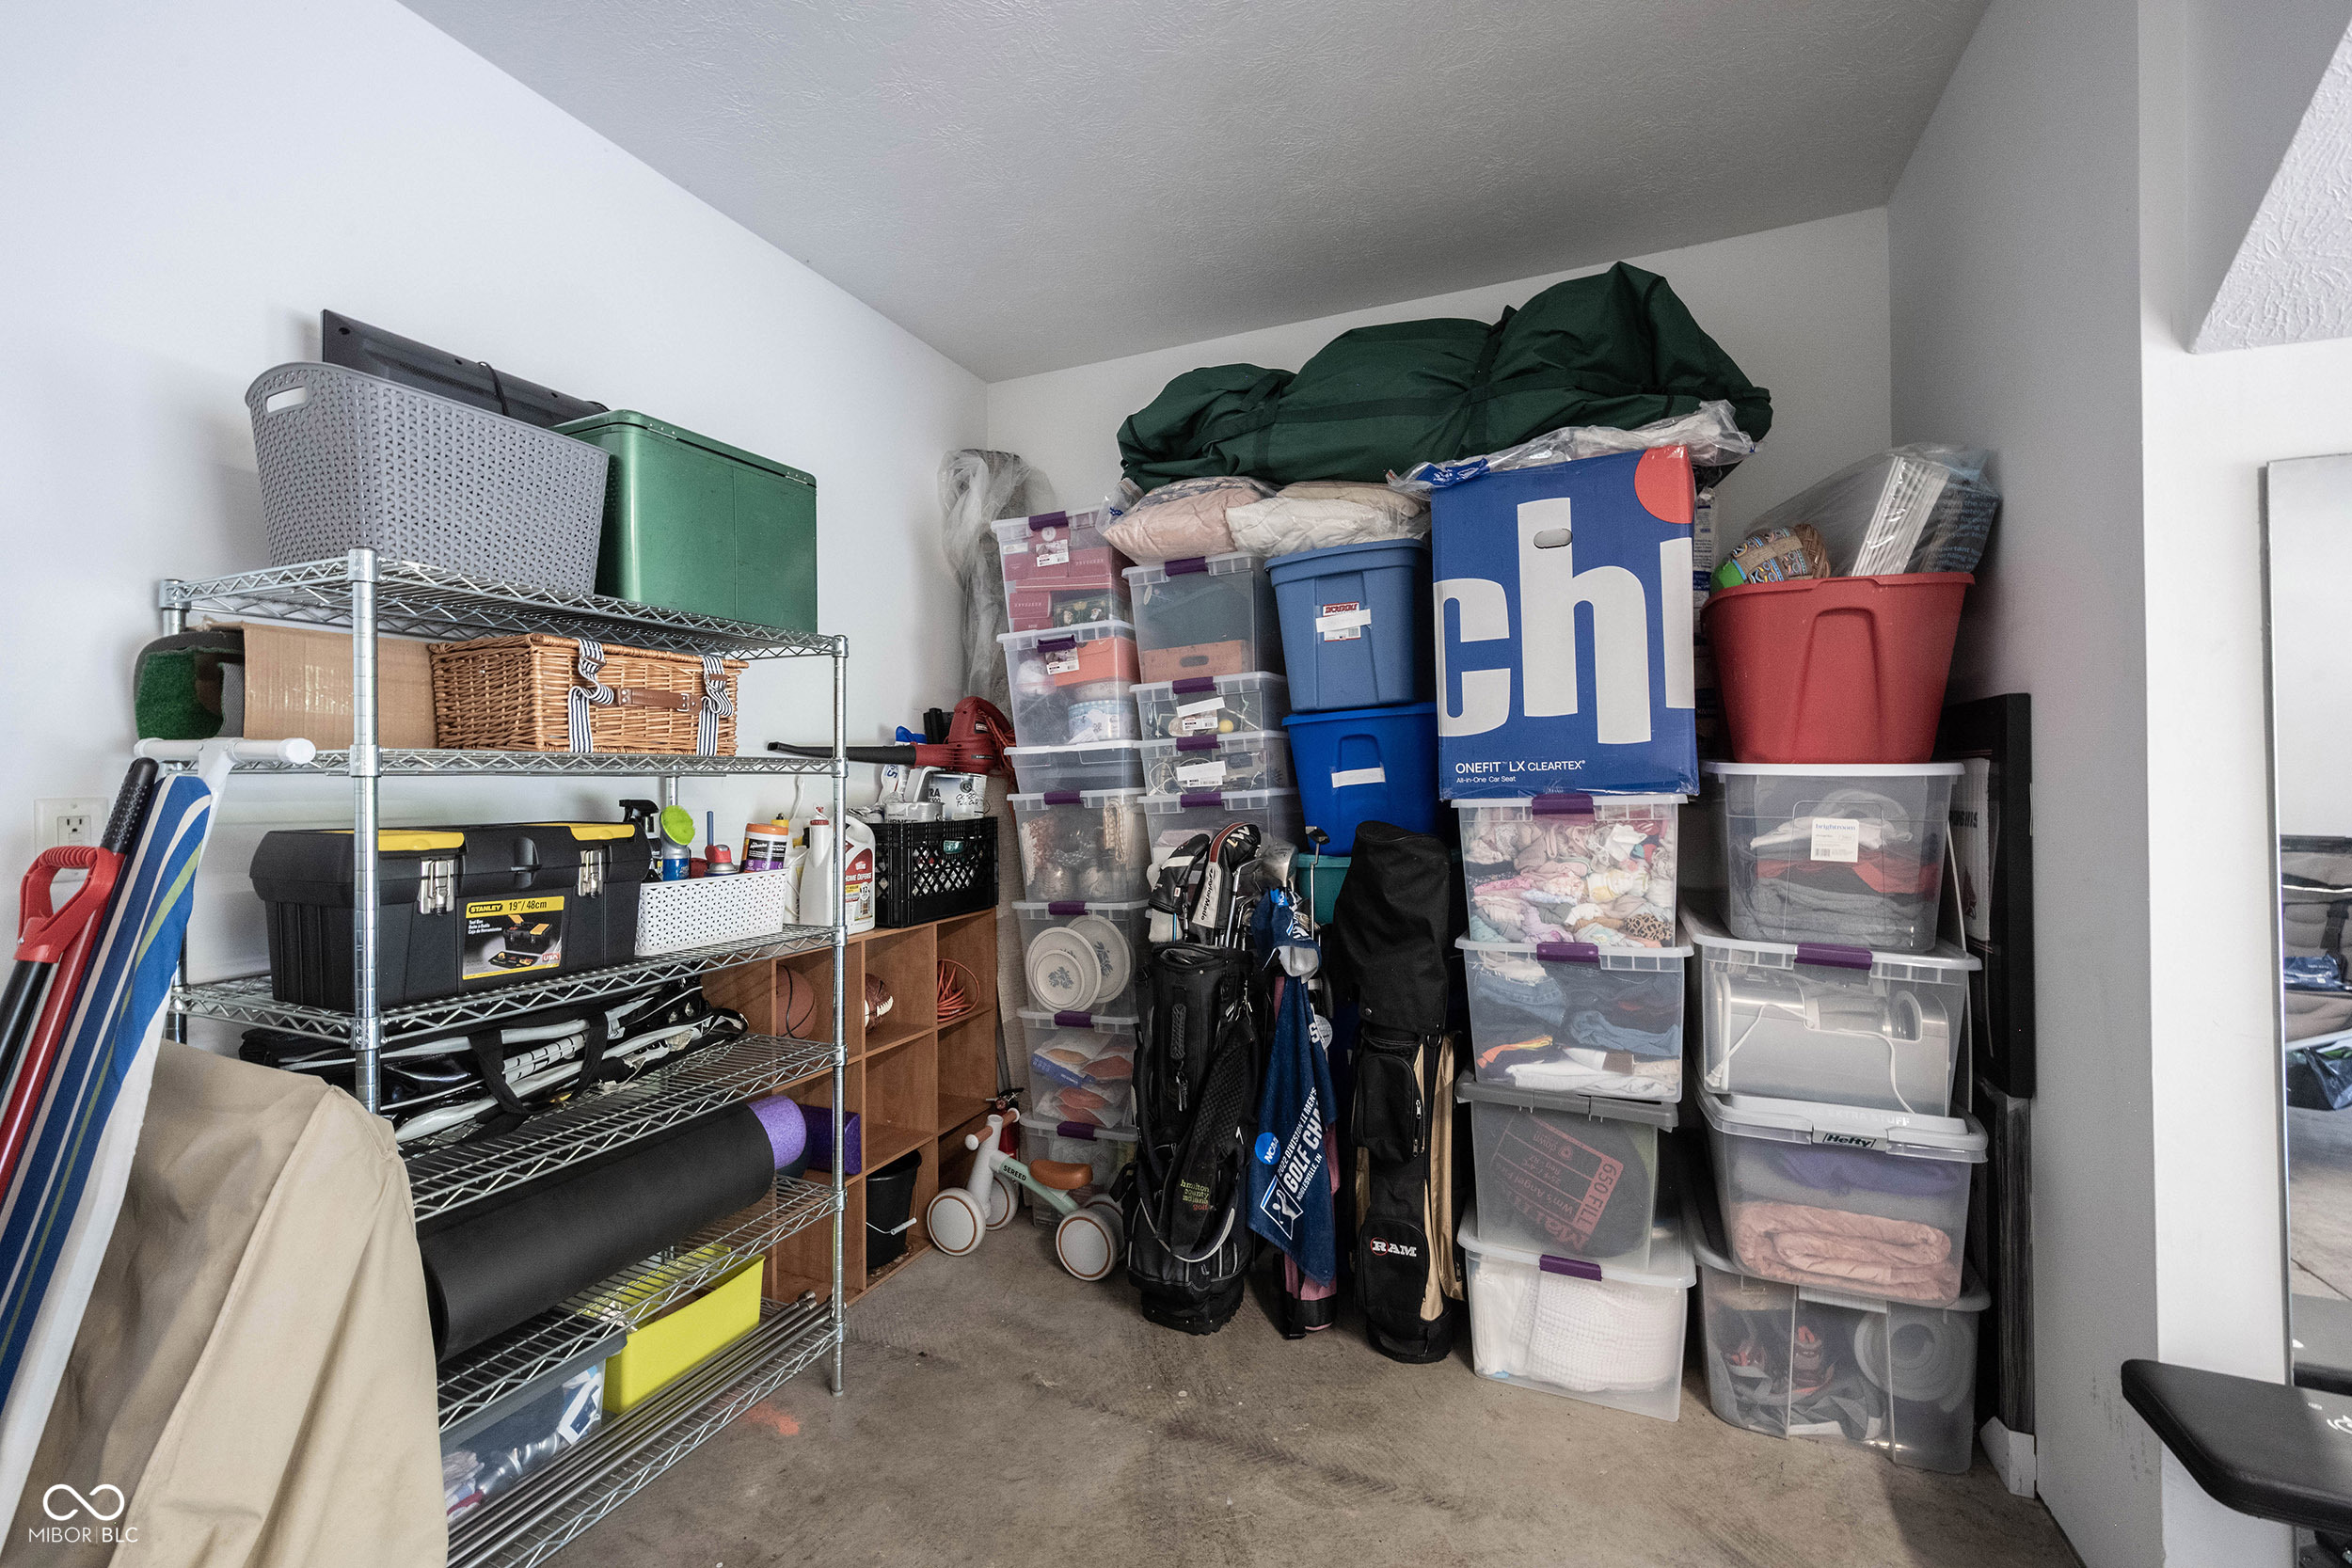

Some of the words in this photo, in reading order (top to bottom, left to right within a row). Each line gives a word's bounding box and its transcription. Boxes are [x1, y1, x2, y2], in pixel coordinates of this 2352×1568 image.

[1509, 760, 1526, 772] LX
[470, 904, 501, 913] STANLEY
[1200, 868, 1216, 921] TaylorMade
[1263, 1136, 1279, 1164] NCAA
[1278, 1157, 1290, 1178] 2022
[1284, 1122, 1304, 1160] DIVISION
[1826, 1134, 1872, 1148] Hefty
[1003, 1165, 1026, 1181] SEREED
[1283, 1144, 1311, 1194] GOLF
[1594, 1163, 1617, 1195] 650
[1579, 1195, 1604, 1226] FILL
[1373, 1241, 1417, 1258] RAM
